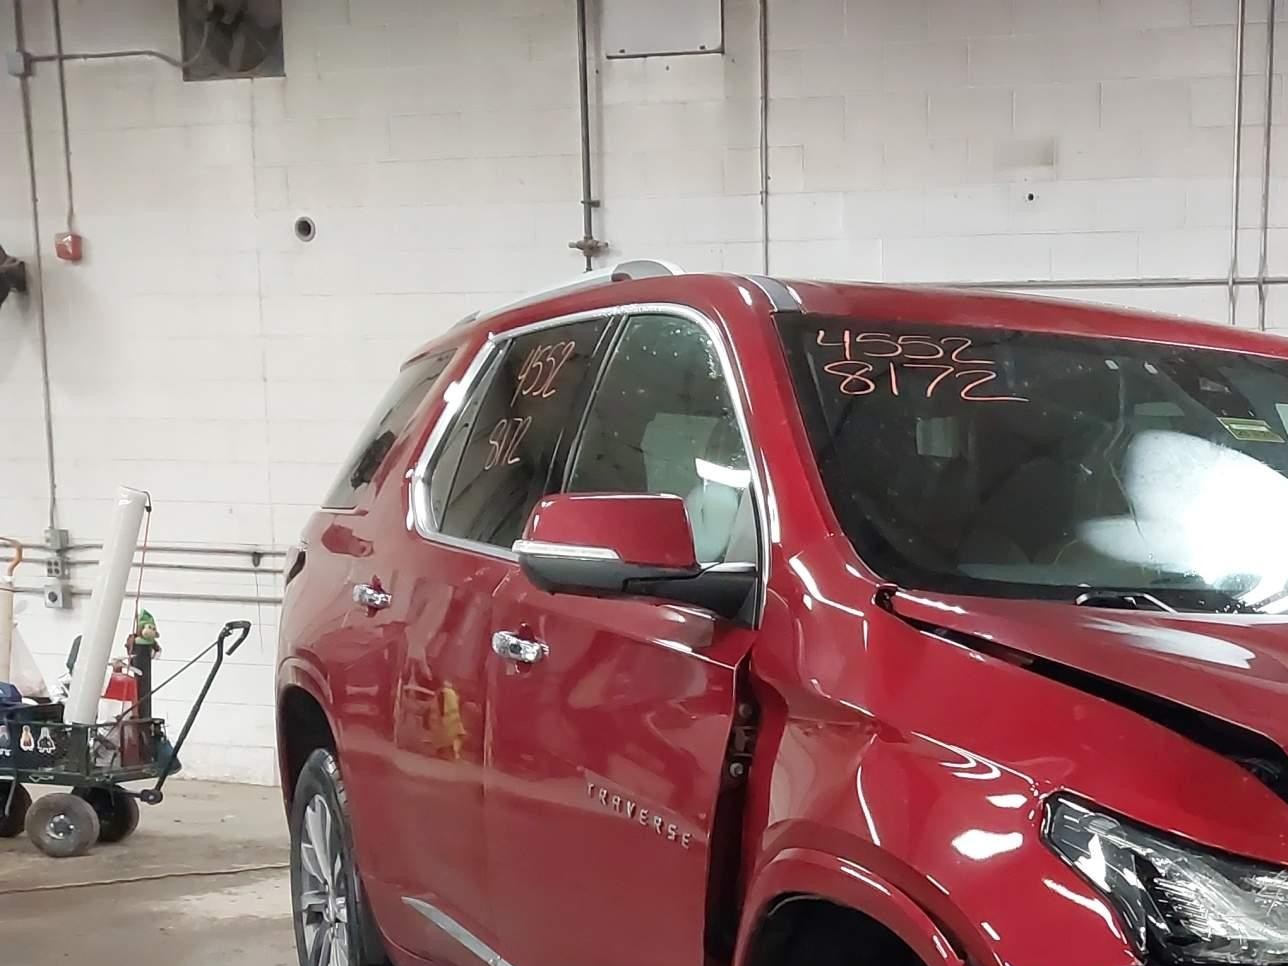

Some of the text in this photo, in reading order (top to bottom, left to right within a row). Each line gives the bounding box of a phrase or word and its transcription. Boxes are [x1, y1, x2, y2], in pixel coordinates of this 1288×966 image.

[816, 329, 995, 364] 4552
[824, 360, 1030, 402] 8172
[586, 781, 692, 849] TRAVERSE
